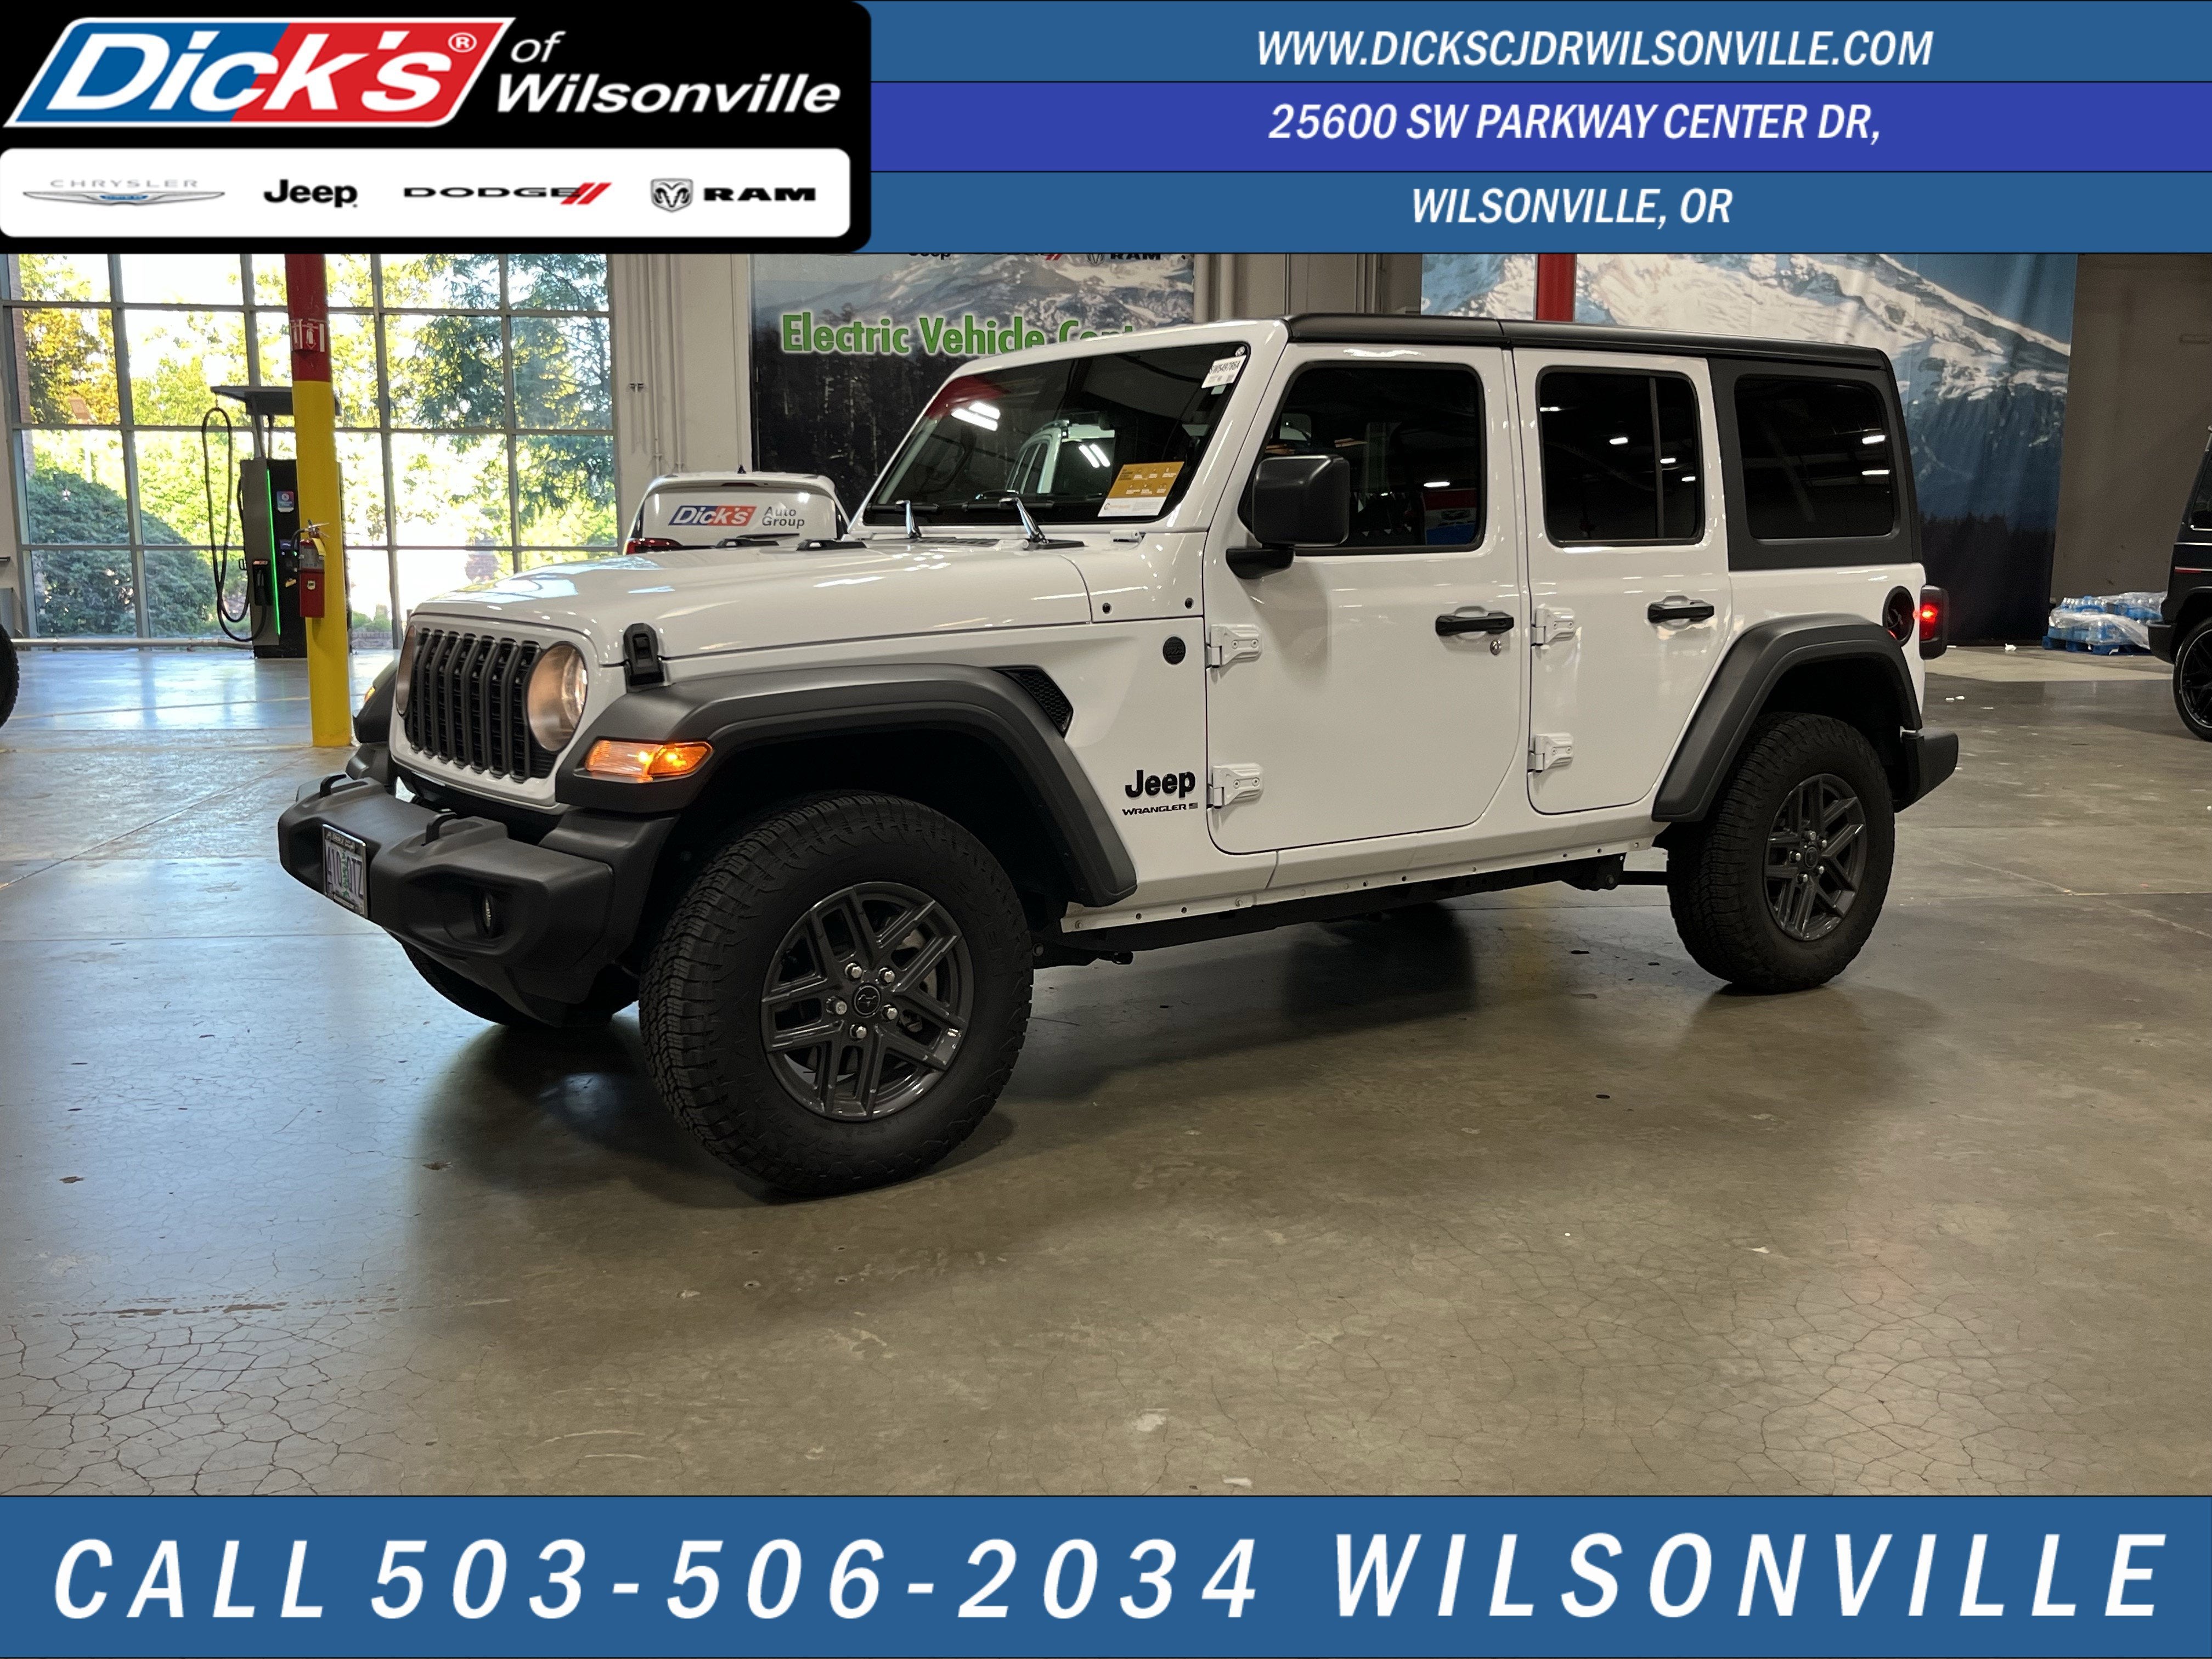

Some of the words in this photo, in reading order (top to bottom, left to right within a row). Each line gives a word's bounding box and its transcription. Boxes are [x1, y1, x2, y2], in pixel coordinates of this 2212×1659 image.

[782, 312, 909, 353] Electric
[919, 315, 1045, 354] Vehicle
[764, 506, 797, 517] Auto
[761, 517, 805, 529] Group
[1125, 769, 1195, 798] Jeep
[1122, 804, 1187, 816] WRANGLER
